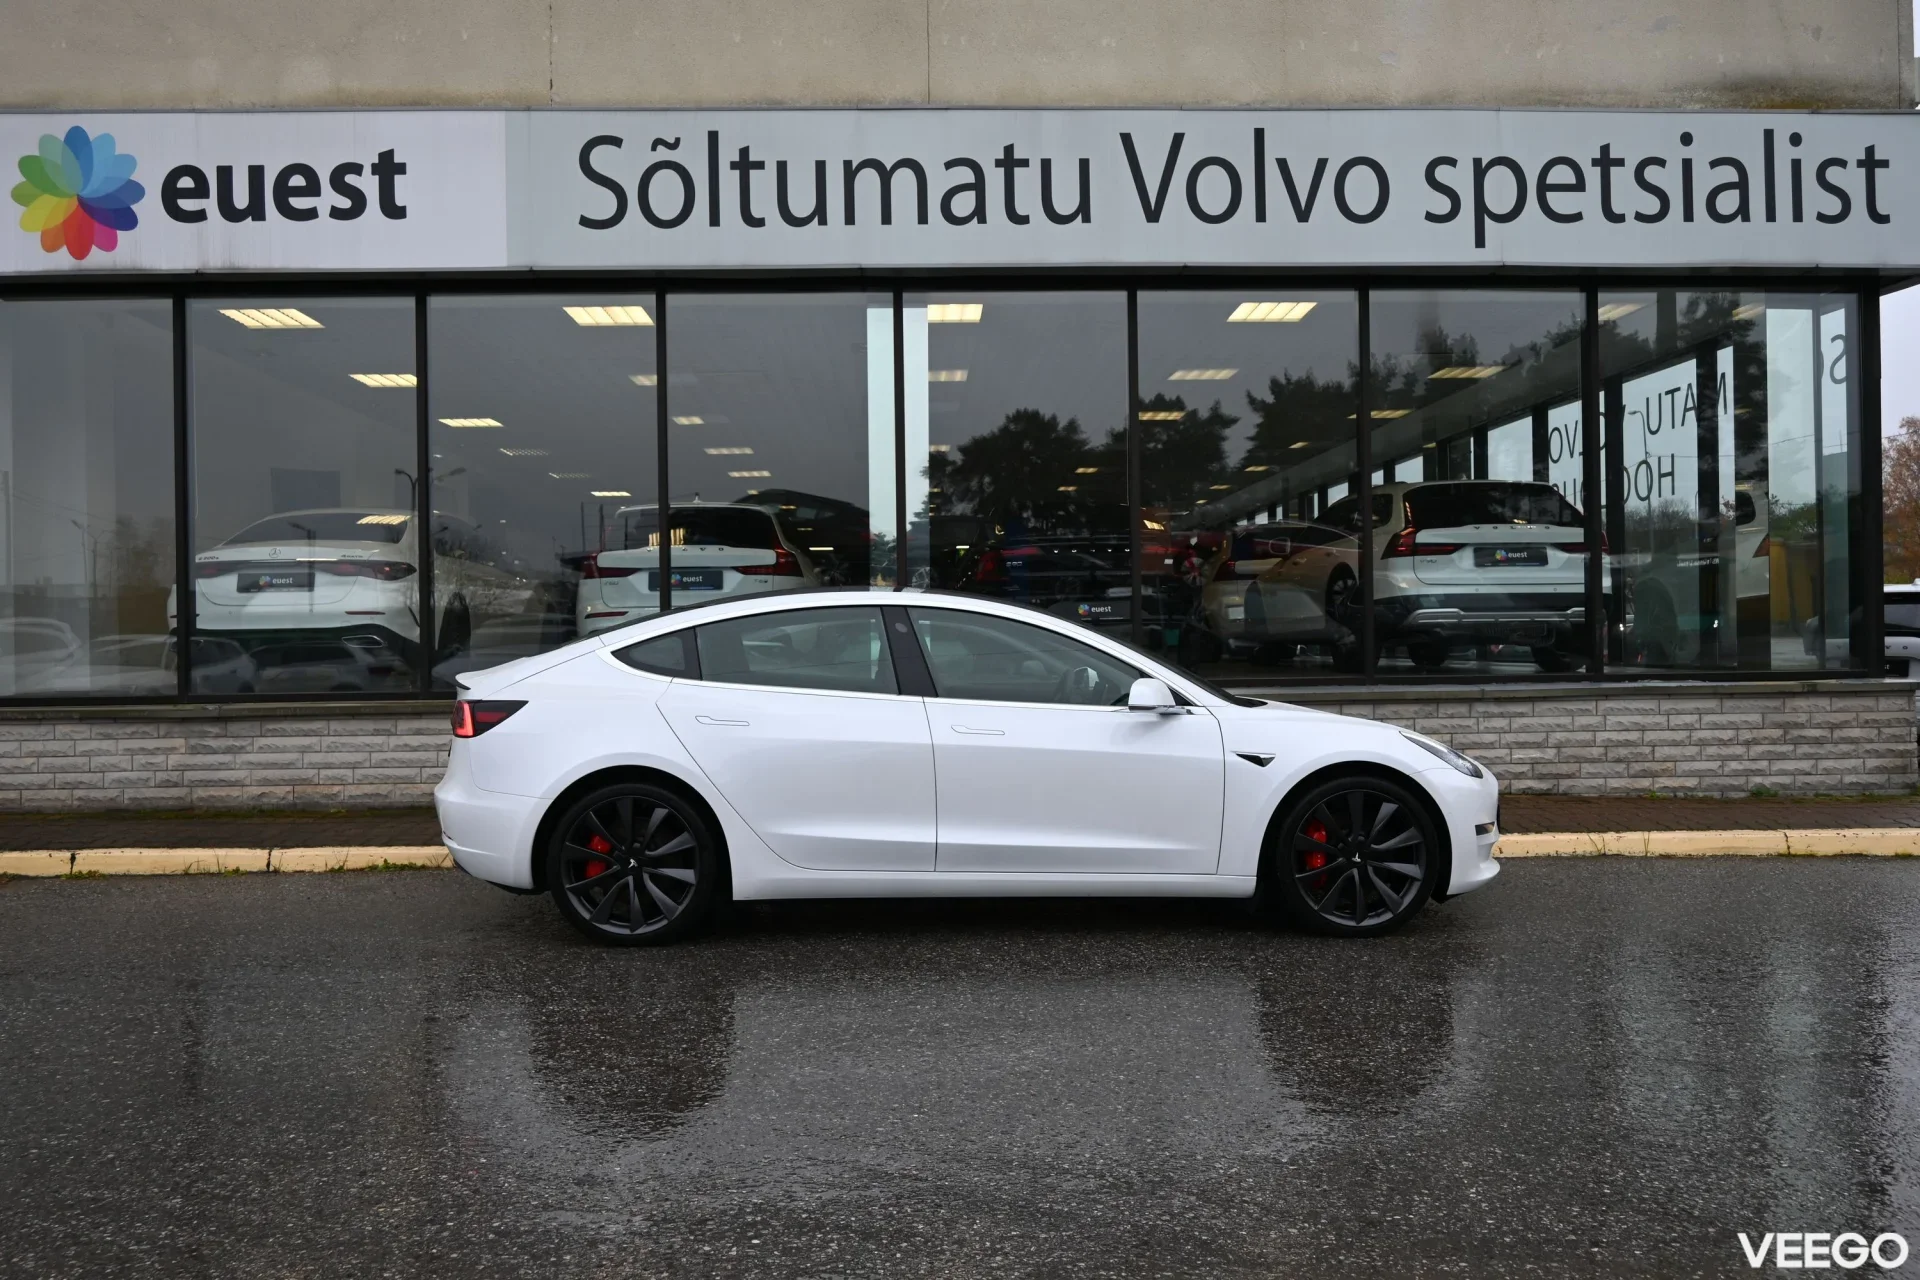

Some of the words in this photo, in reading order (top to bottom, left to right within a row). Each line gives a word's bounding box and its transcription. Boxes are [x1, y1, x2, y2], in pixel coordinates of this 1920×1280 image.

[161, 149, 406, 222] euest
[579, 131, 1091, 230] Sõltumatu
[1119, 128, 1390, 225] Volvo
[1425, 129, 1890, 248] spetsialist
[1508, 551, 1528, 559] euest
[682, 575, 703, 583] euest
[1091, 604, 1111, 613] euest
